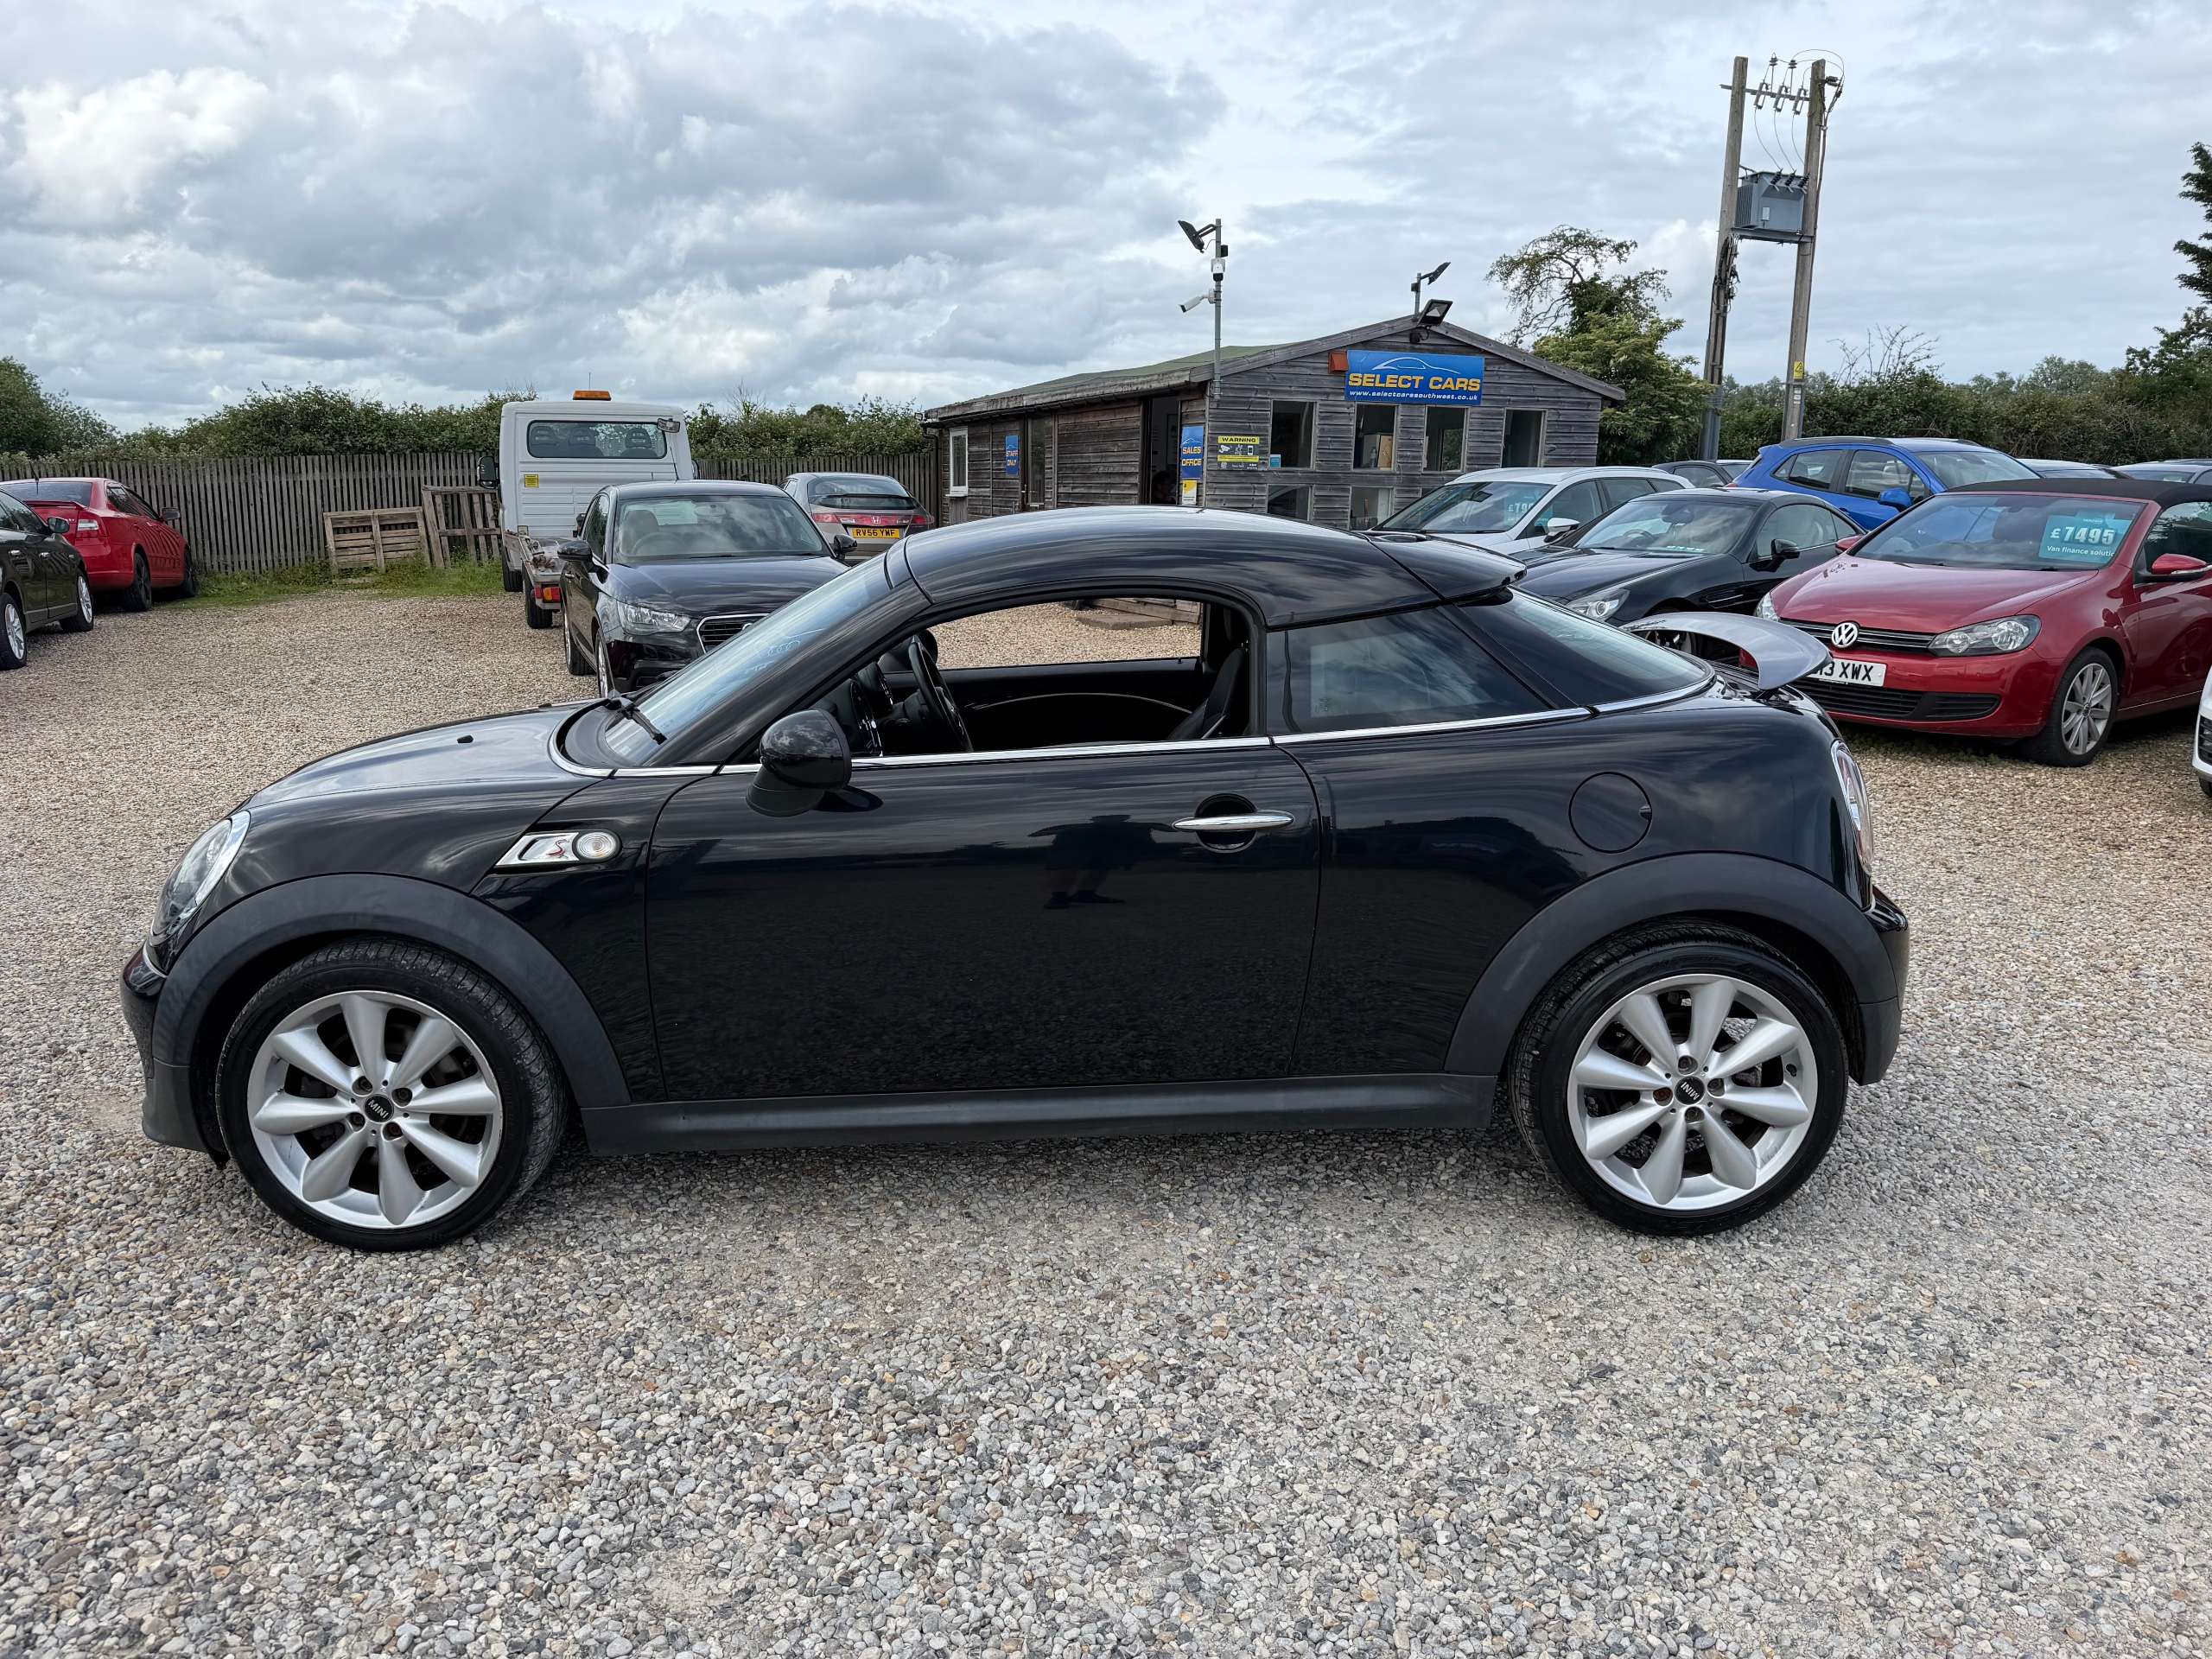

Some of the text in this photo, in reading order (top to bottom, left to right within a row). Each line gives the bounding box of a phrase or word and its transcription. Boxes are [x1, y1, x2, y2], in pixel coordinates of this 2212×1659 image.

[1348, 373, 1481, 391] SELECT CARS
[1349, 390, 1478, 401] www.selectcarssouthwest.co.uk
[1182, 446, 1202, 454] SALES
[1181, 458, 1202, 467] OFFICE
[2050, 526, 2116, 545] £7495
[1839, 662, 1874, 682] XWX
[368, 1099, 389, 1119] MINI
